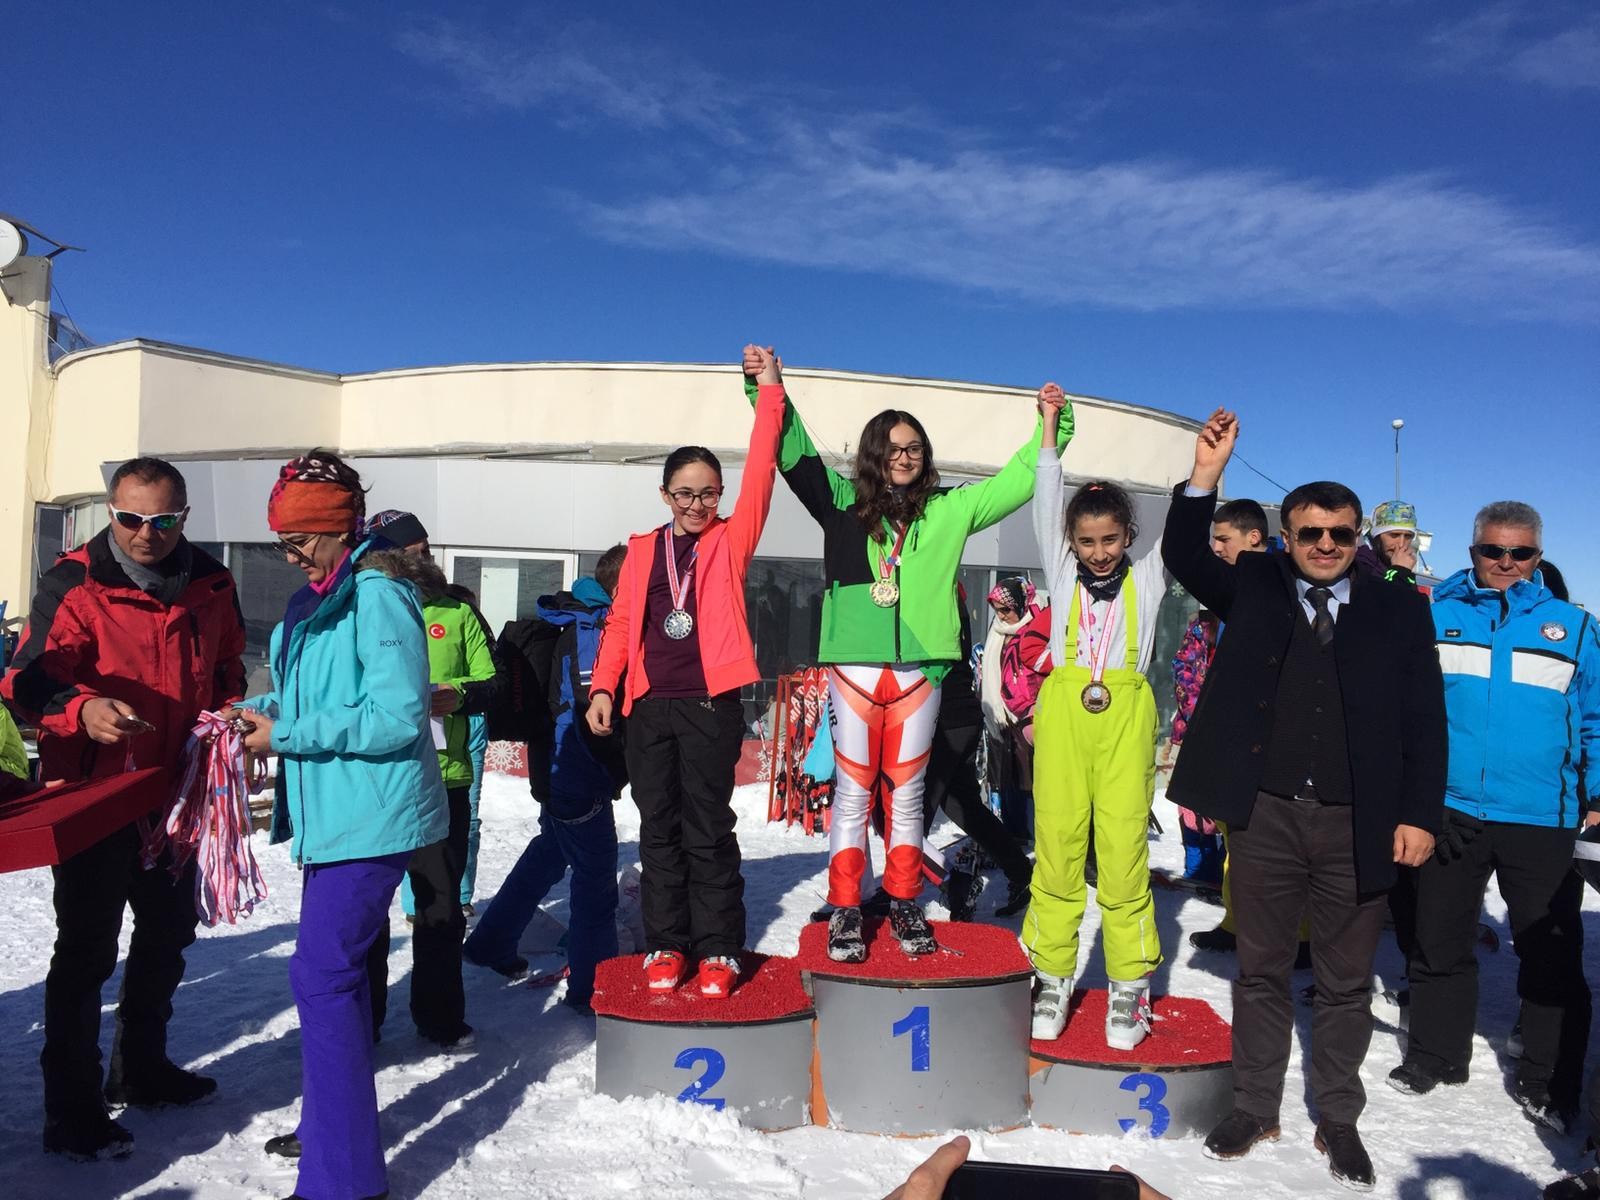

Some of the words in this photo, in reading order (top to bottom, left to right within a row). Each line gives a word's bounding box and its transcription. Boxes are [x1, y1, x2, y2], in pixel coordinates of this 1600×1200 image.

[379, 639, 403, 648] ROXY
[892, 1006, 930, 1072] 1
[674, 1047, 726, 1112] 2
[1118, 1072, 1170, 1138] 3
